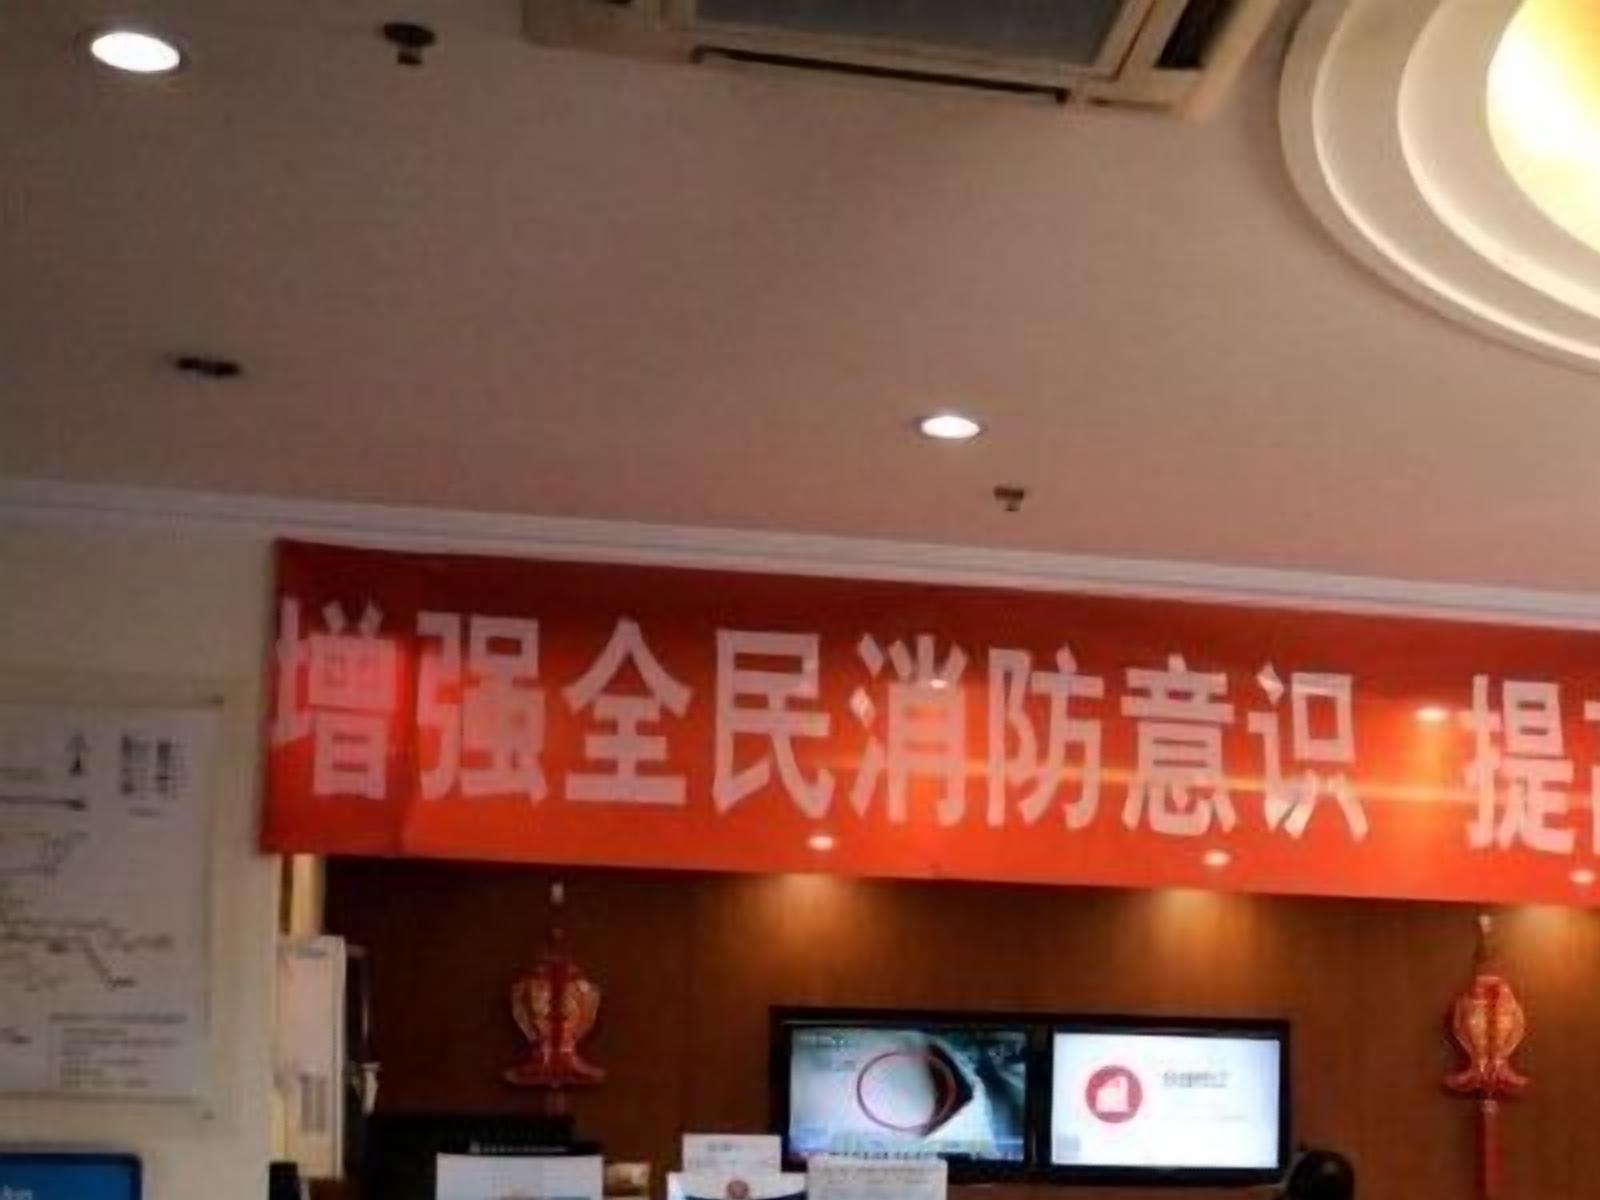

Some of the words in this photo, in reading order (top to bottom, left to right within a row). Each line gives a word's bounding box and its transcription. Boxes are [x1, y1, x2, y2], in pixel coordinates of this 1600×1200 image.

[270, 597, 1367, 840] 增强全民消防意识
